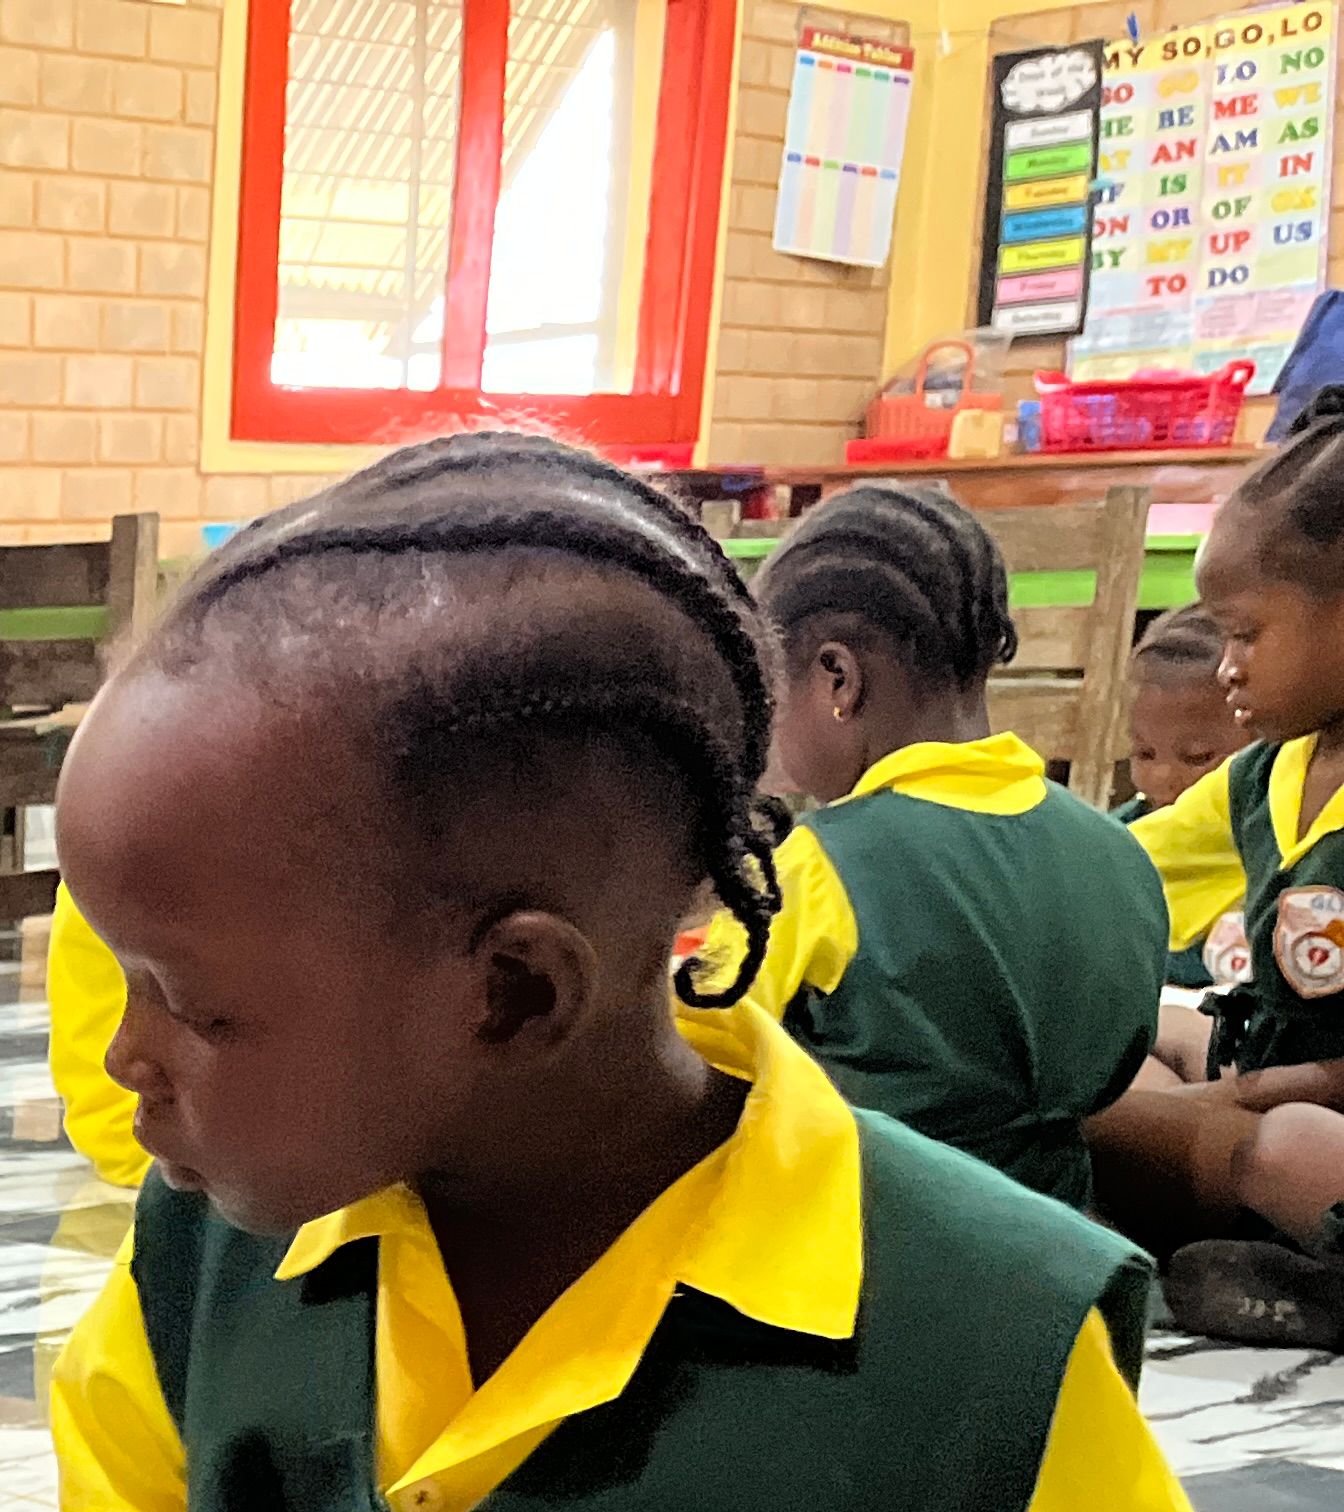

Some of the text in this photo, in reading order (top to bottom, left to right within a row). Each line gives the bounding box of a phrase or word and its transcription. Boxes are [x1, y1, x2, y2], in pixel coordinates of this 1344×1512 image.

[1280, 47, 1325, 74] NO
[1157, 82, 1322, 131] BE ME WE
[1151, 117, 1320, 165] AN AM AS
[1159, 152, 1314, 197] IS IT IN
[1150, 206, 1191, 230] OR
[1211, 195, 1253, 220] OF
[1146, 220, 1314, 264] MY UP US
[1146, 264, 1250, 297] TO DO
